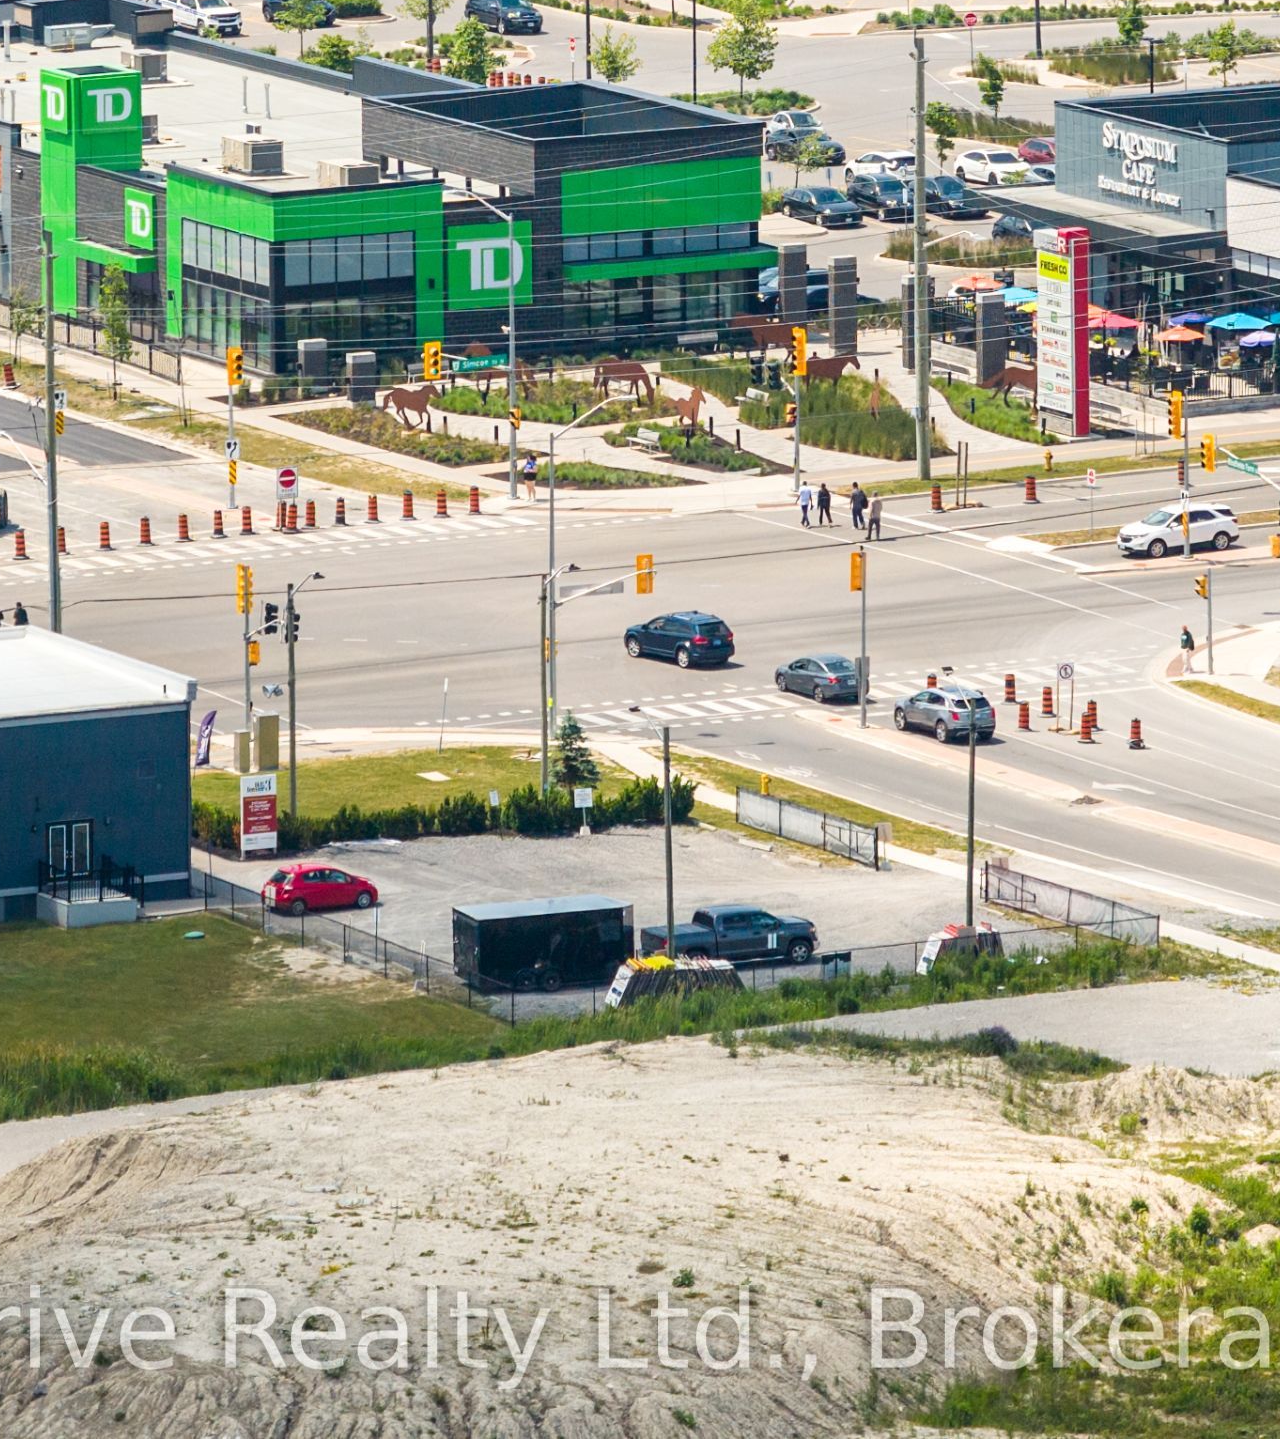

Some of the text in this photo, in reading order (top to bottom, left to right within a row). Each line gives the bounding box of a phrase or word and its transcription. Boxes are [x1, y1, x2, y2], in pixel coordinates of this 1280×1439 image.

[43, 83, 66, 122] TD
[86, 87, 133, 124] TD
[1102, 121, 1179, 164] SYMPOSIUM
[1122, 160, 1156, 185] CAFE
[126, 198, 151, 238] TD
[1057, 237, 1066, 253] R
[455, 238, 524, 291] TD
[1040, 260, 1068, 275] FRESH CO
